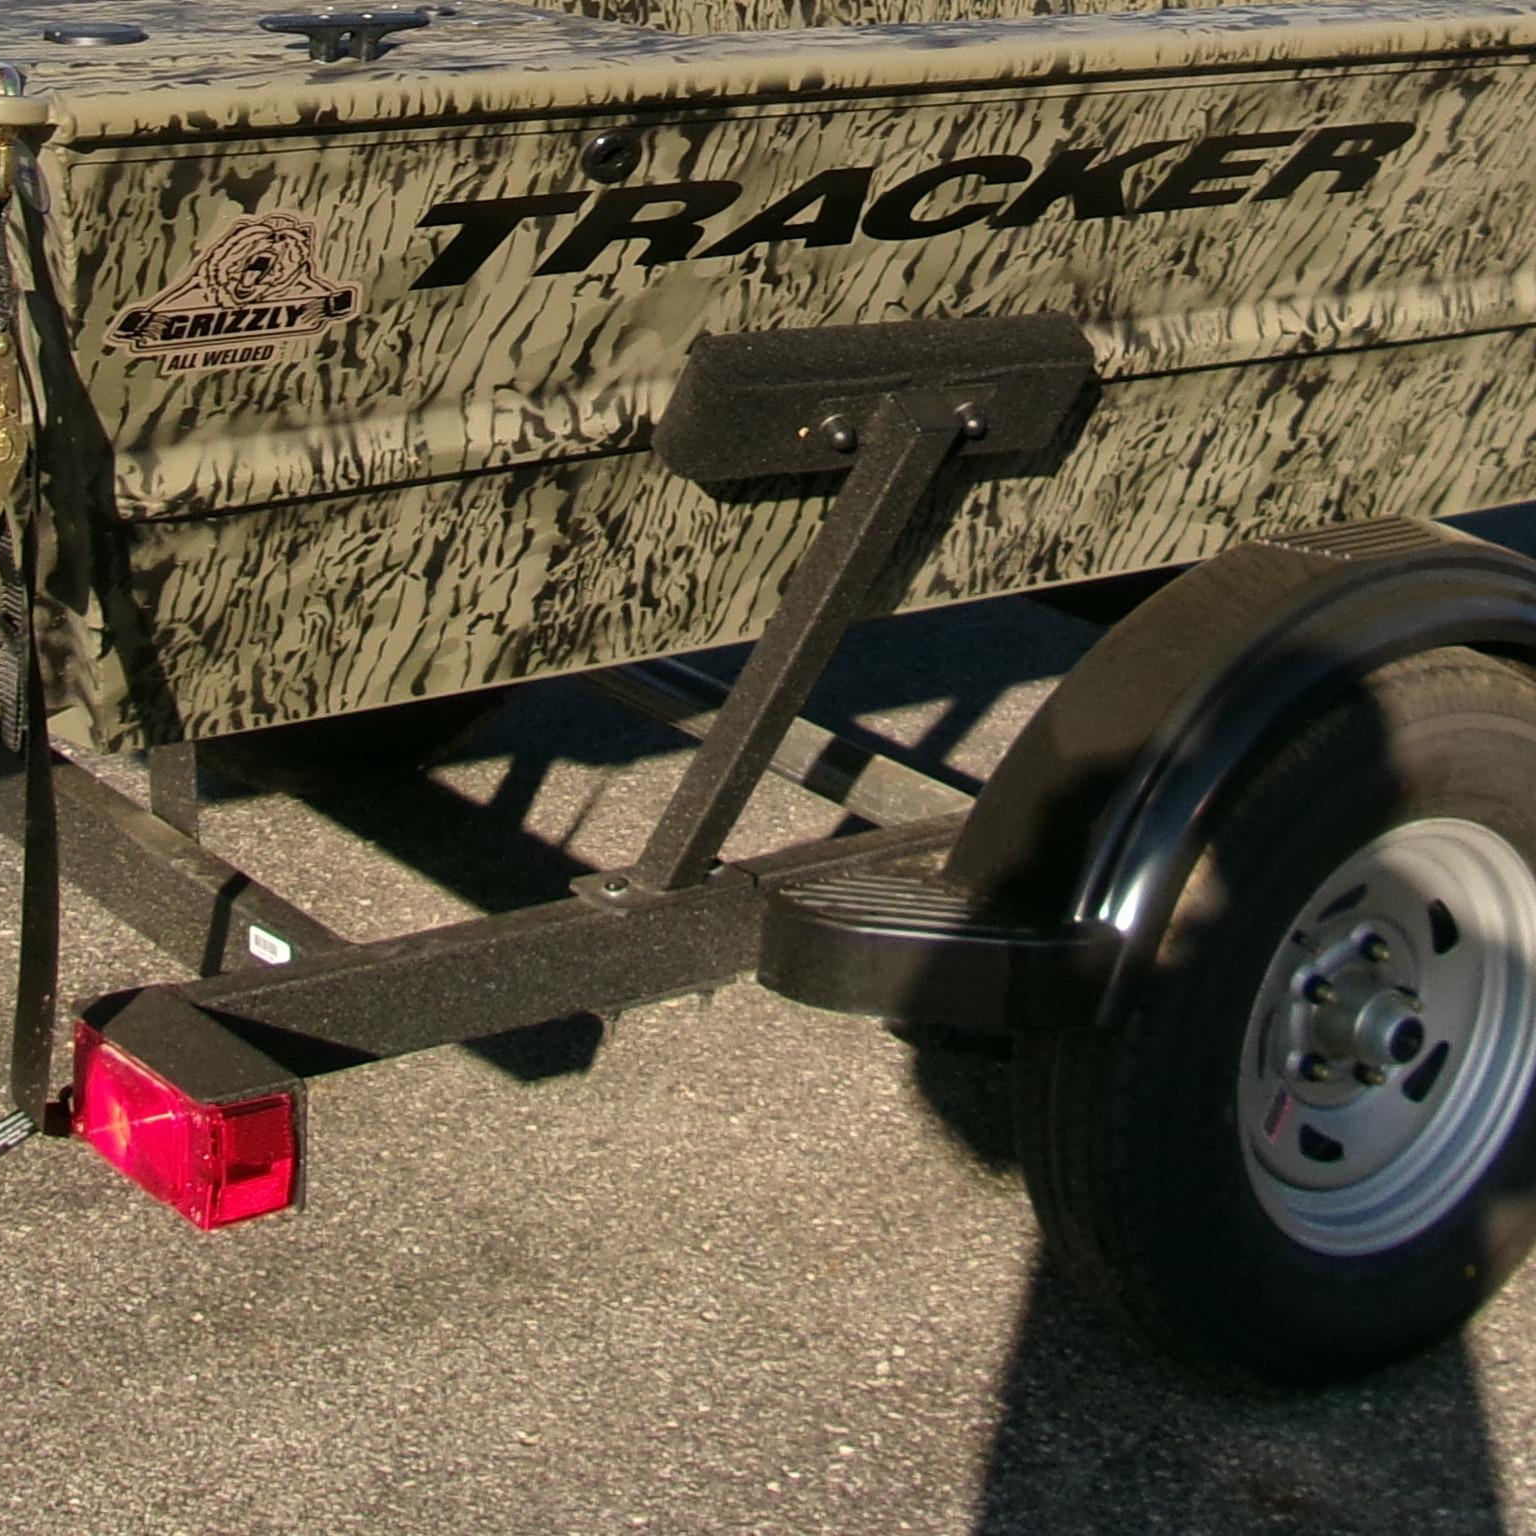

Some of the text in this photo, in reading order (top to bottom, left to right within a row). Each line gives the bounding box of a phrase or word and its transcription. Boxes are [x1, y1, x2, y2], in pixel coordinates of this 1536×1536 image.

[408, 121, 1416, 291] TRACKER
[160, 304, 308, 341] GRIZZLY
[166, 344, 275, 371] ALL WELDED
